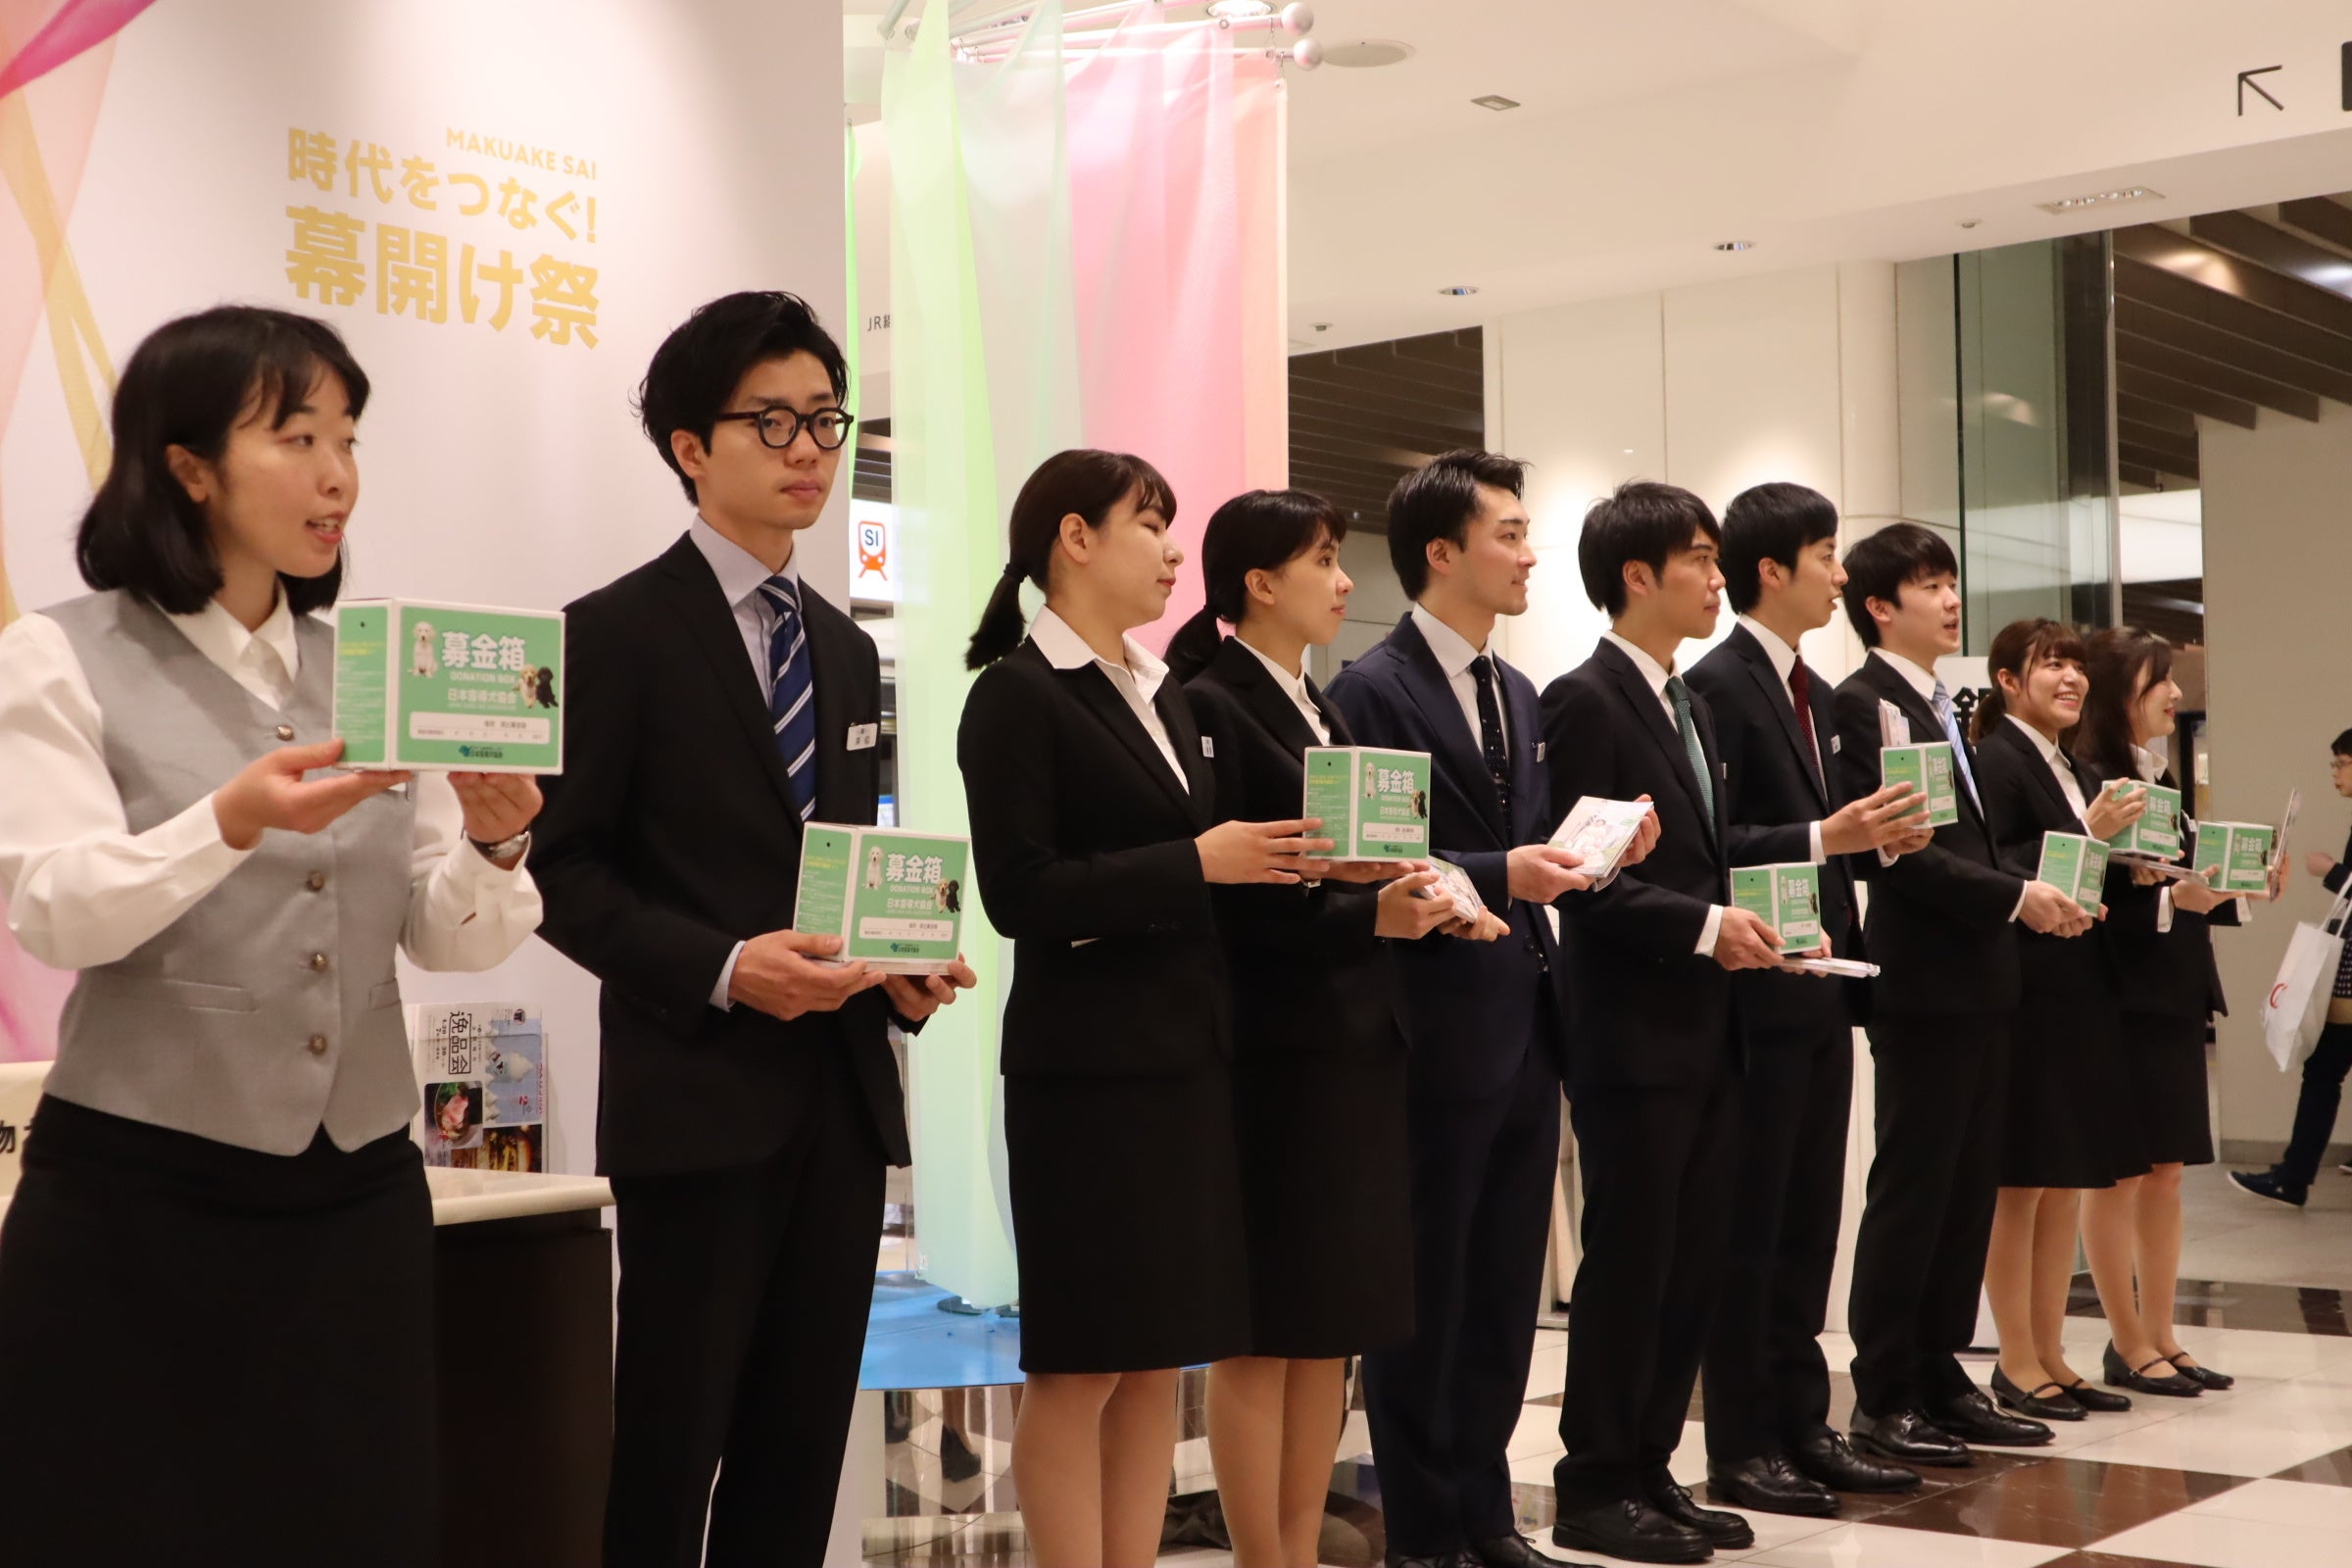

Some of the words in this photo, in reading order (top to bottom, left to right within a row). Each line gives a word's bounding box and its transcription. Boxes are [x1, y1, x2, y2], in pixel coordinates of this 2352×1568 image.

[445, 126, 557, 172] MAKUAKE
[564, 156, 597, 180] SAI
[288, 126, 597, 243] 時代をつなぐ!
[285, 205, 600, 350] 幕開け祭
[441, 630, 525, 671] 募金箱
[1377, 768, 1414, 794] 募金箱
[885, 853, 943, 884] 募金箱
